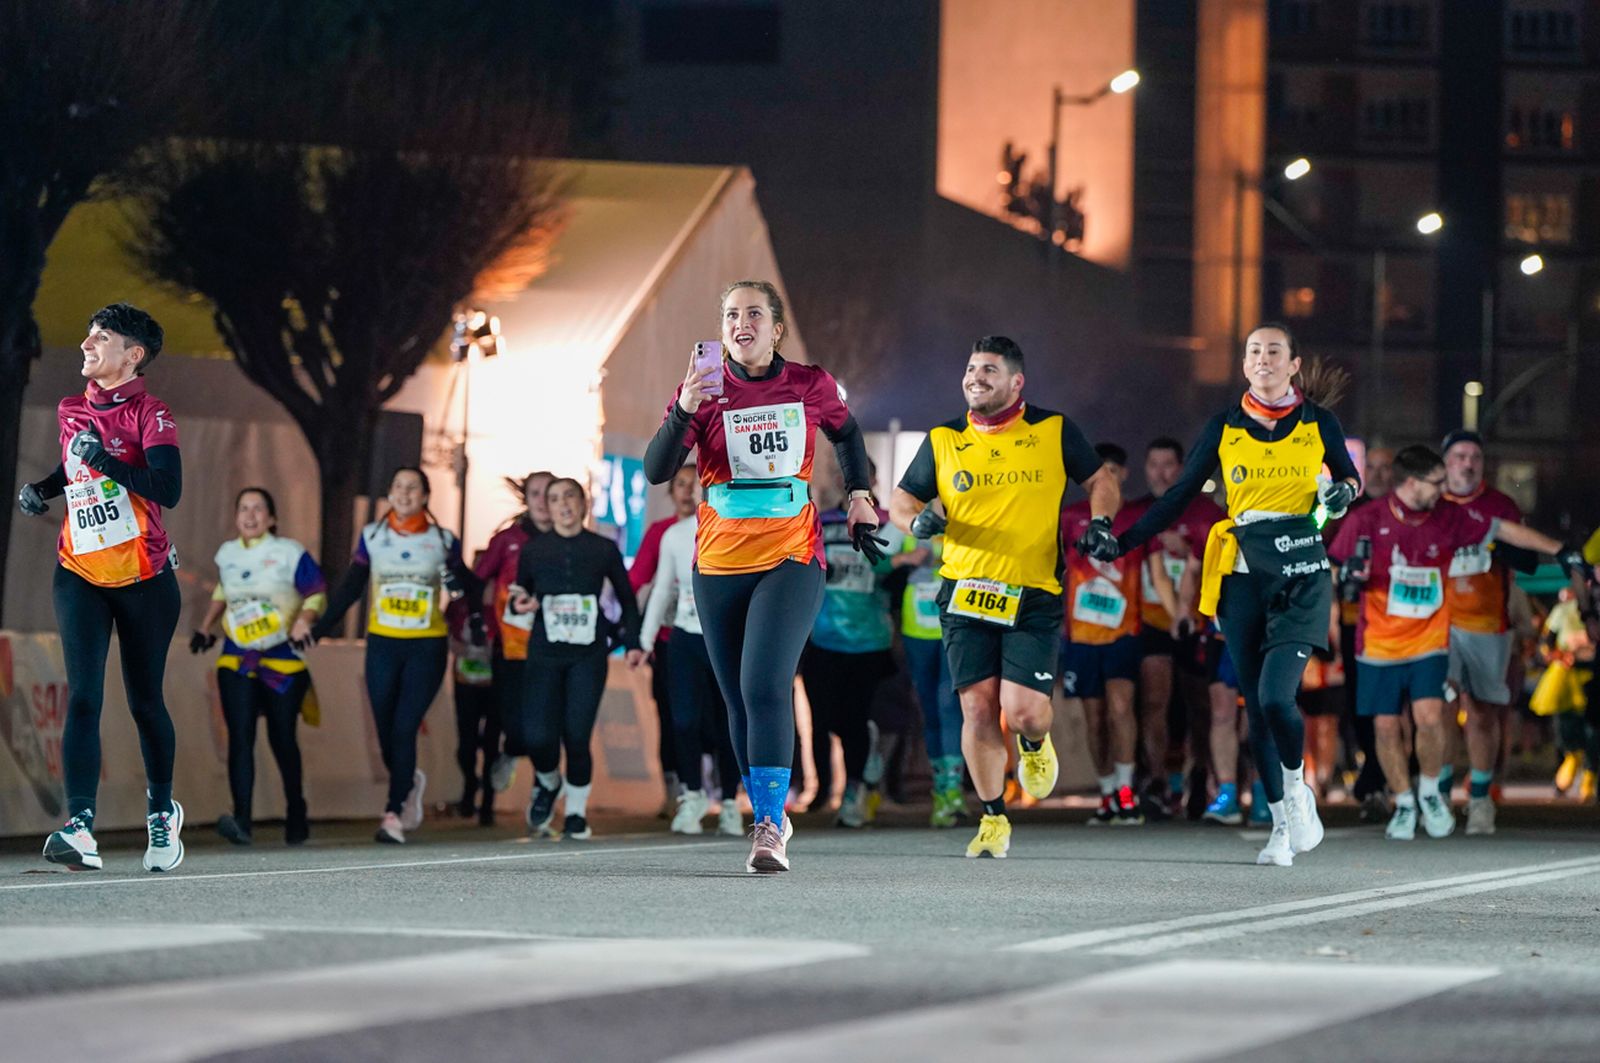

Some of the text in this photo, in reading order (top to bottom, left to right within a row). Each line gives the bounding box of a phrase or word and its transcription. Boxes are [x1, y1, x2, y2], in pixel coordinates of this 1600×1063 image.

[734, 421, 778, 434] SAN ANTÓN
[743, 414, 766, 423] NOCHE
[749, 430, 789, 455] 845
[953, 470, 1044, 492] AIRZONE
[1231, 465, 1310, 484] AIRZONE
[86, 488, 96, 497] DE
[77, 500, 120, 530] 6605
[976, 583, 1000, 593] ANTÓN
[965, 590, 1009, 612] 4164
